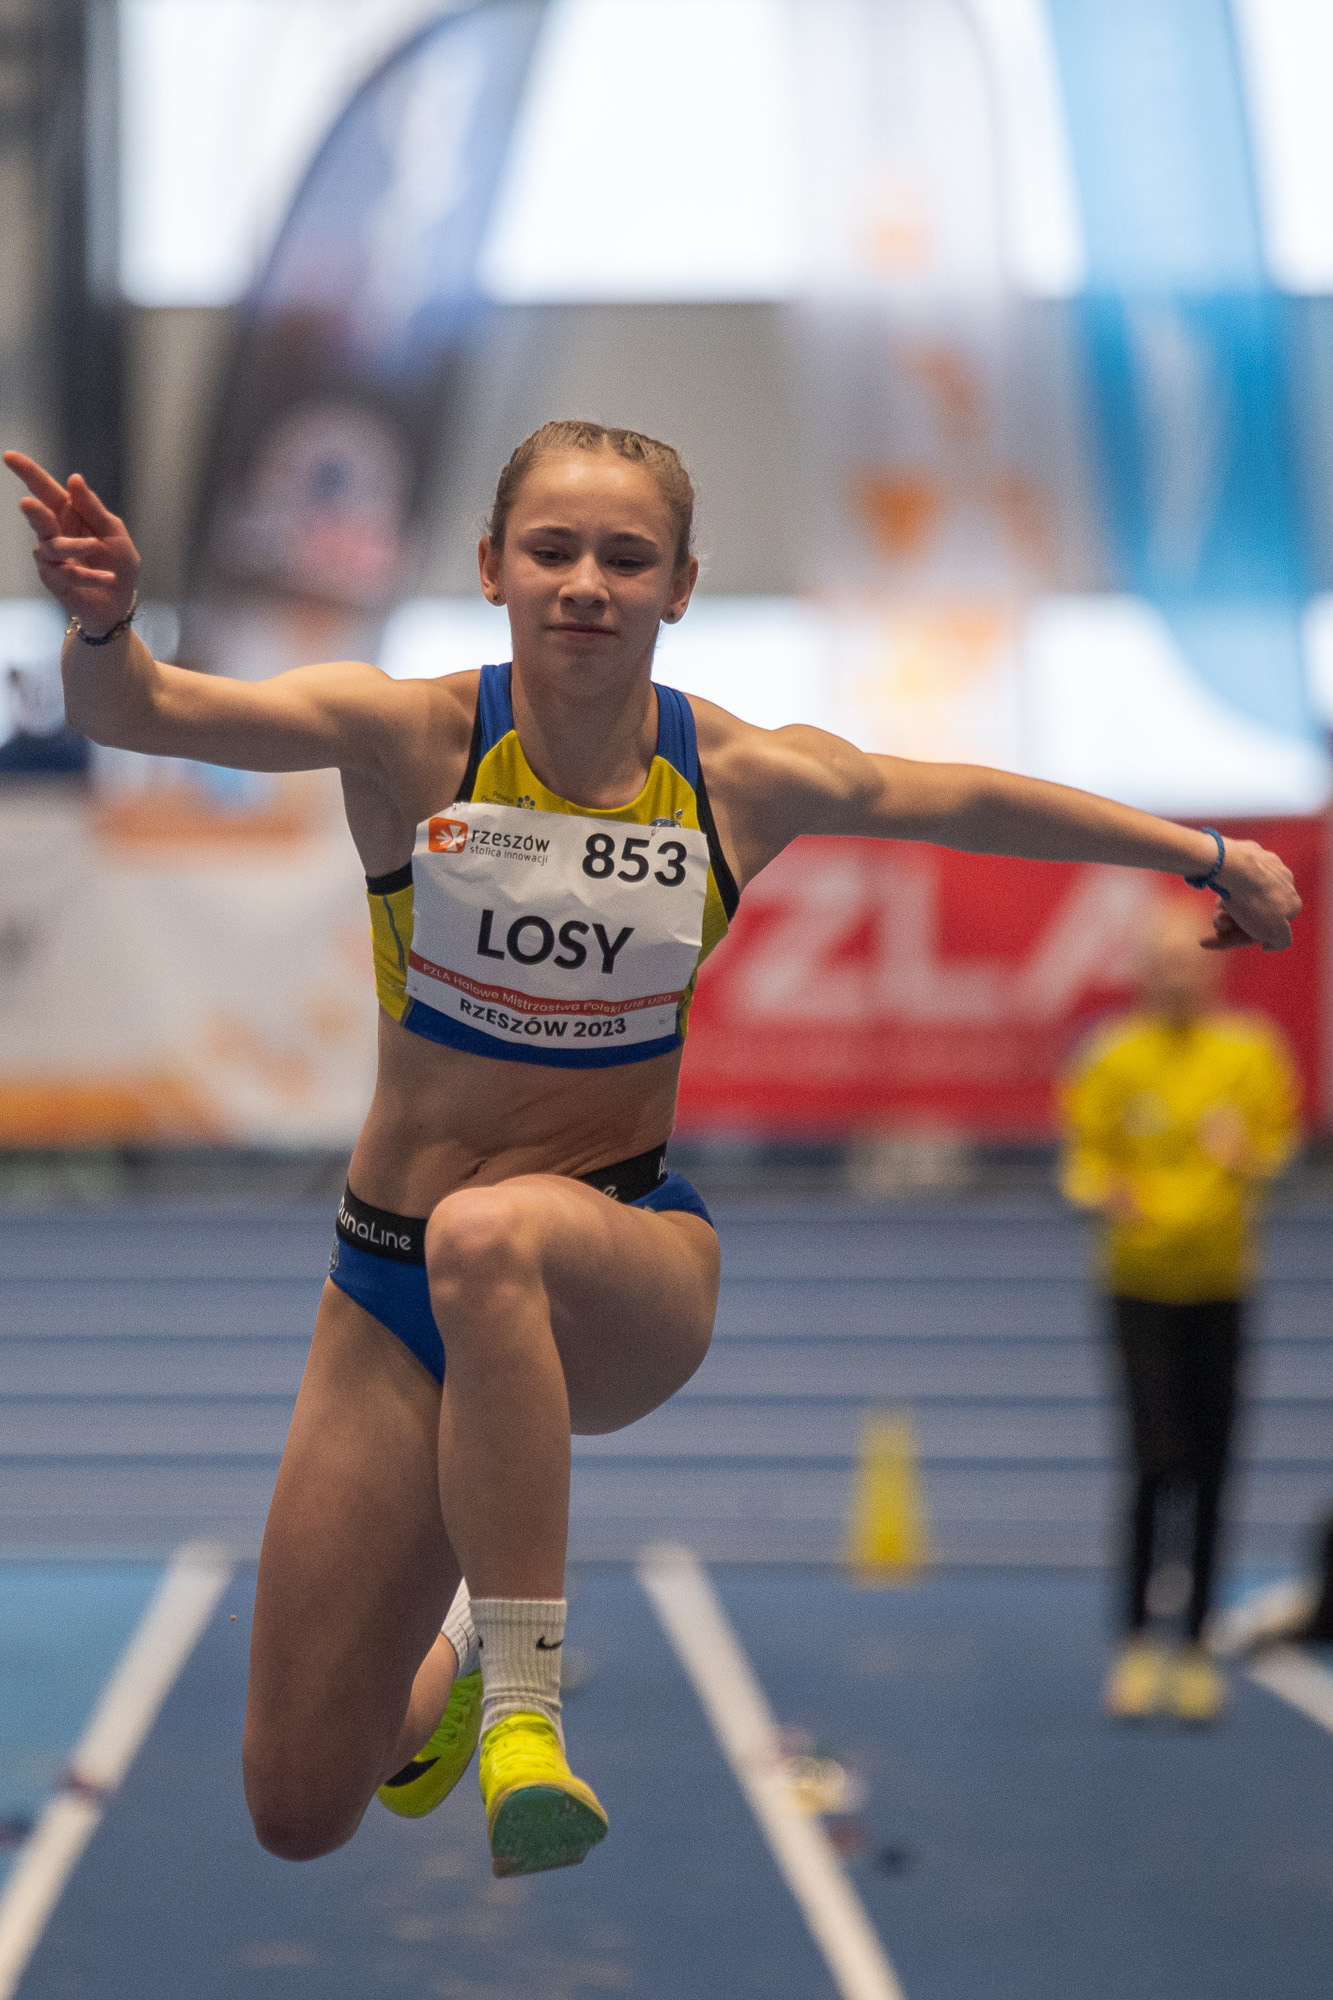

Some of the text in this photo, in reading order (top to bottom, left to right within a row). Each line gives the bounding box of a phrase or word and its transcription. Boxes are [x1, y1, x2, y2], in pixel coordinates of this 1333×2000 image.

[469, 845, 549, 867] stolica innowacji
[471, 829, 550, 853] rzeszów
[581, 832, 688, 888] 853
[476, 908, 636, 975] LOSY
[422, 963, 451, 981] PZLA
[453, 975, 499, 999] Halowe
[502, 992, 581, 1012] Mistrzostwa
[583, 1001, 621, 1014] Polski
[459, 997, 627, 1038] RZESZÓW 2023
